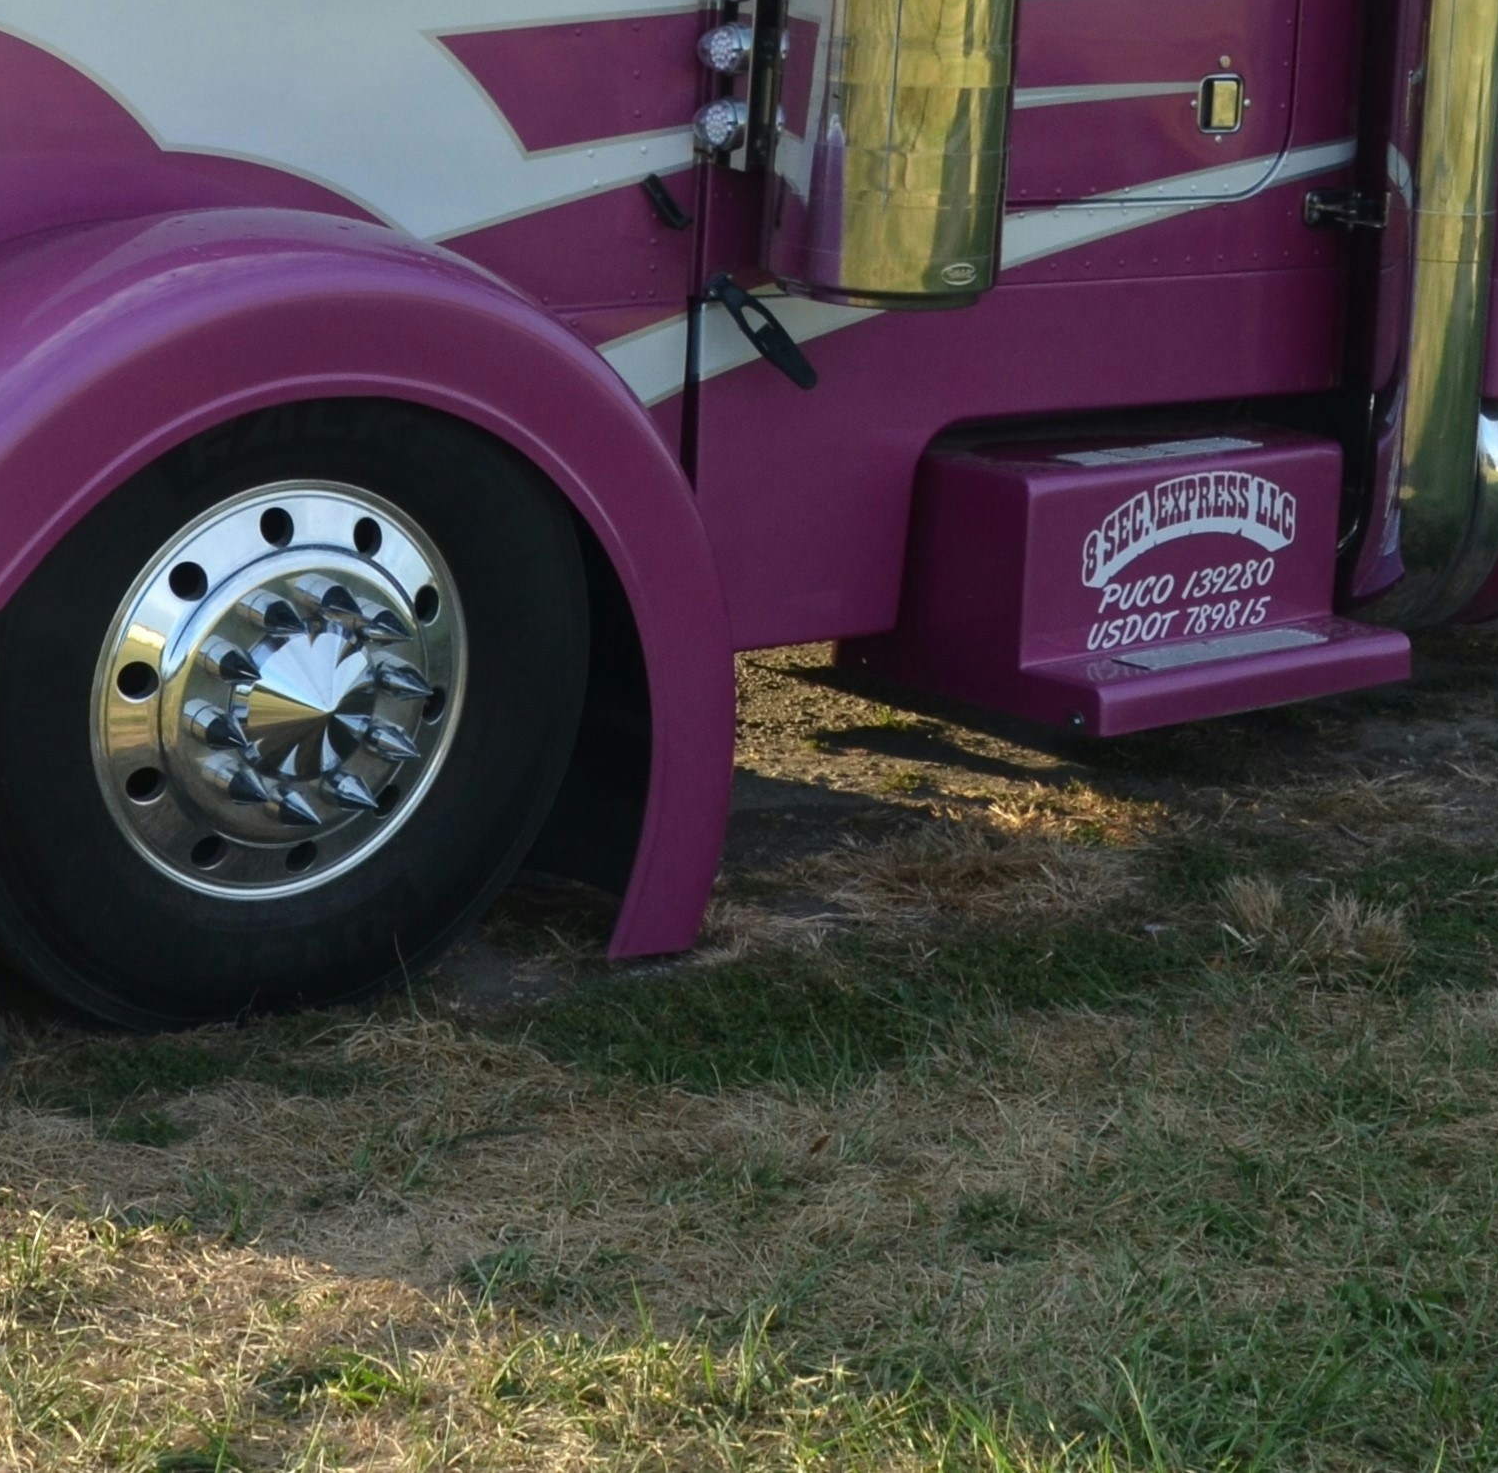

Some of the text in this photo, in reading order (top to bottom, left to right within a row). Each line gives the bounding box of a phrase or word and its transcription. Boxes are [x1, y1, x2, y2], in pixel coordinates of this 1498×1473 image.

[1082, 471, 1296, 588] 8 SEC. EXPRESS LLC
[1098, 557, 1275, 613] PUCO 139280
[1087, 596, 1271, 651] USDOT 789815
